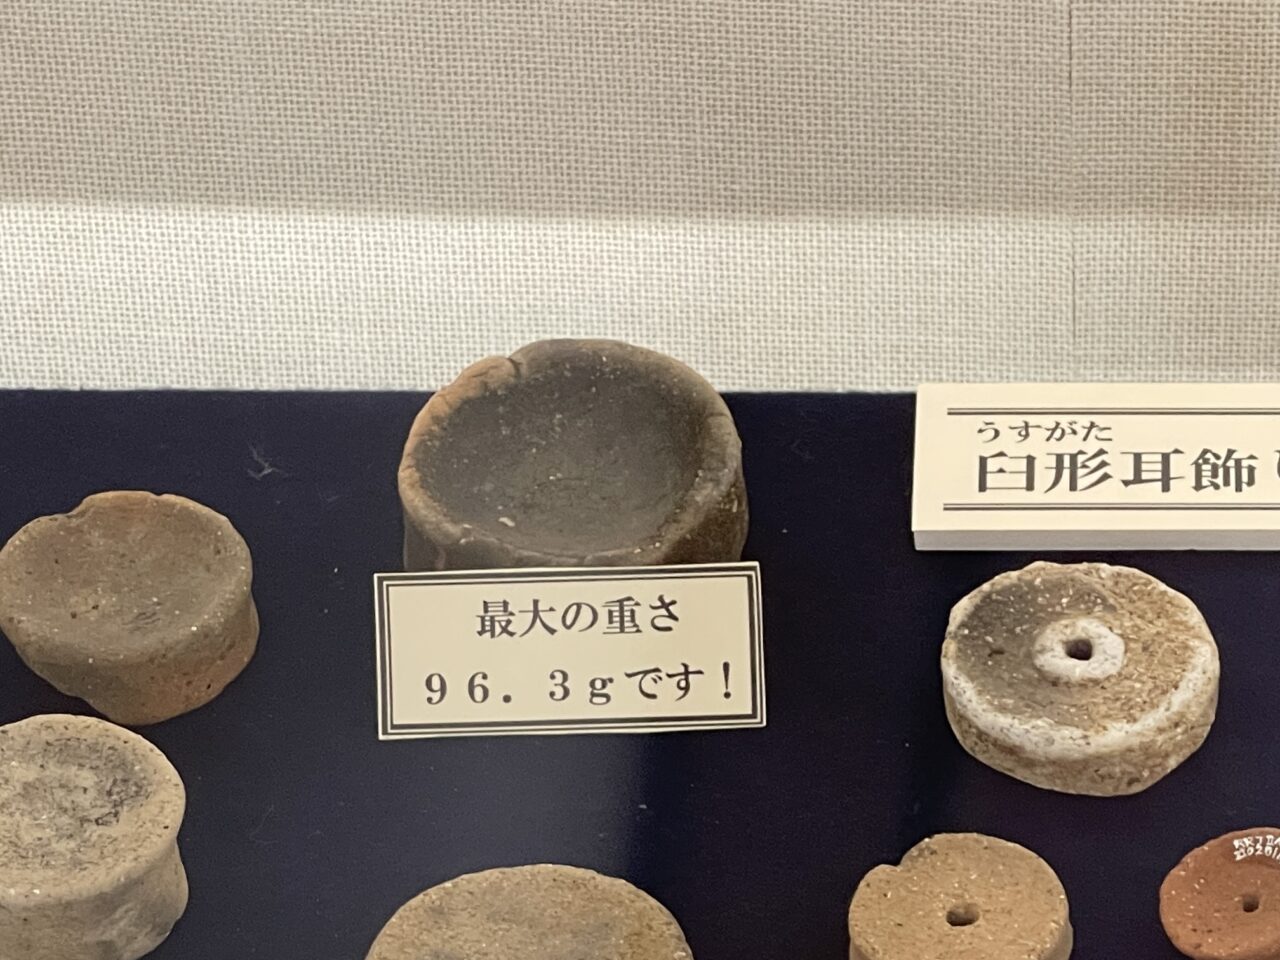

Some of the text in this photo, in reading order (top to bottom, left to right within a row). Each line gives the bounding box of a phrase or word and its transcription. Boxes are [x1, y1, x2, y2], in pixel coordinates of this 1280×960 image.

[977, 420, 1113, 443] うすがた
[476, 594, 680, 639] 最大の重さ
